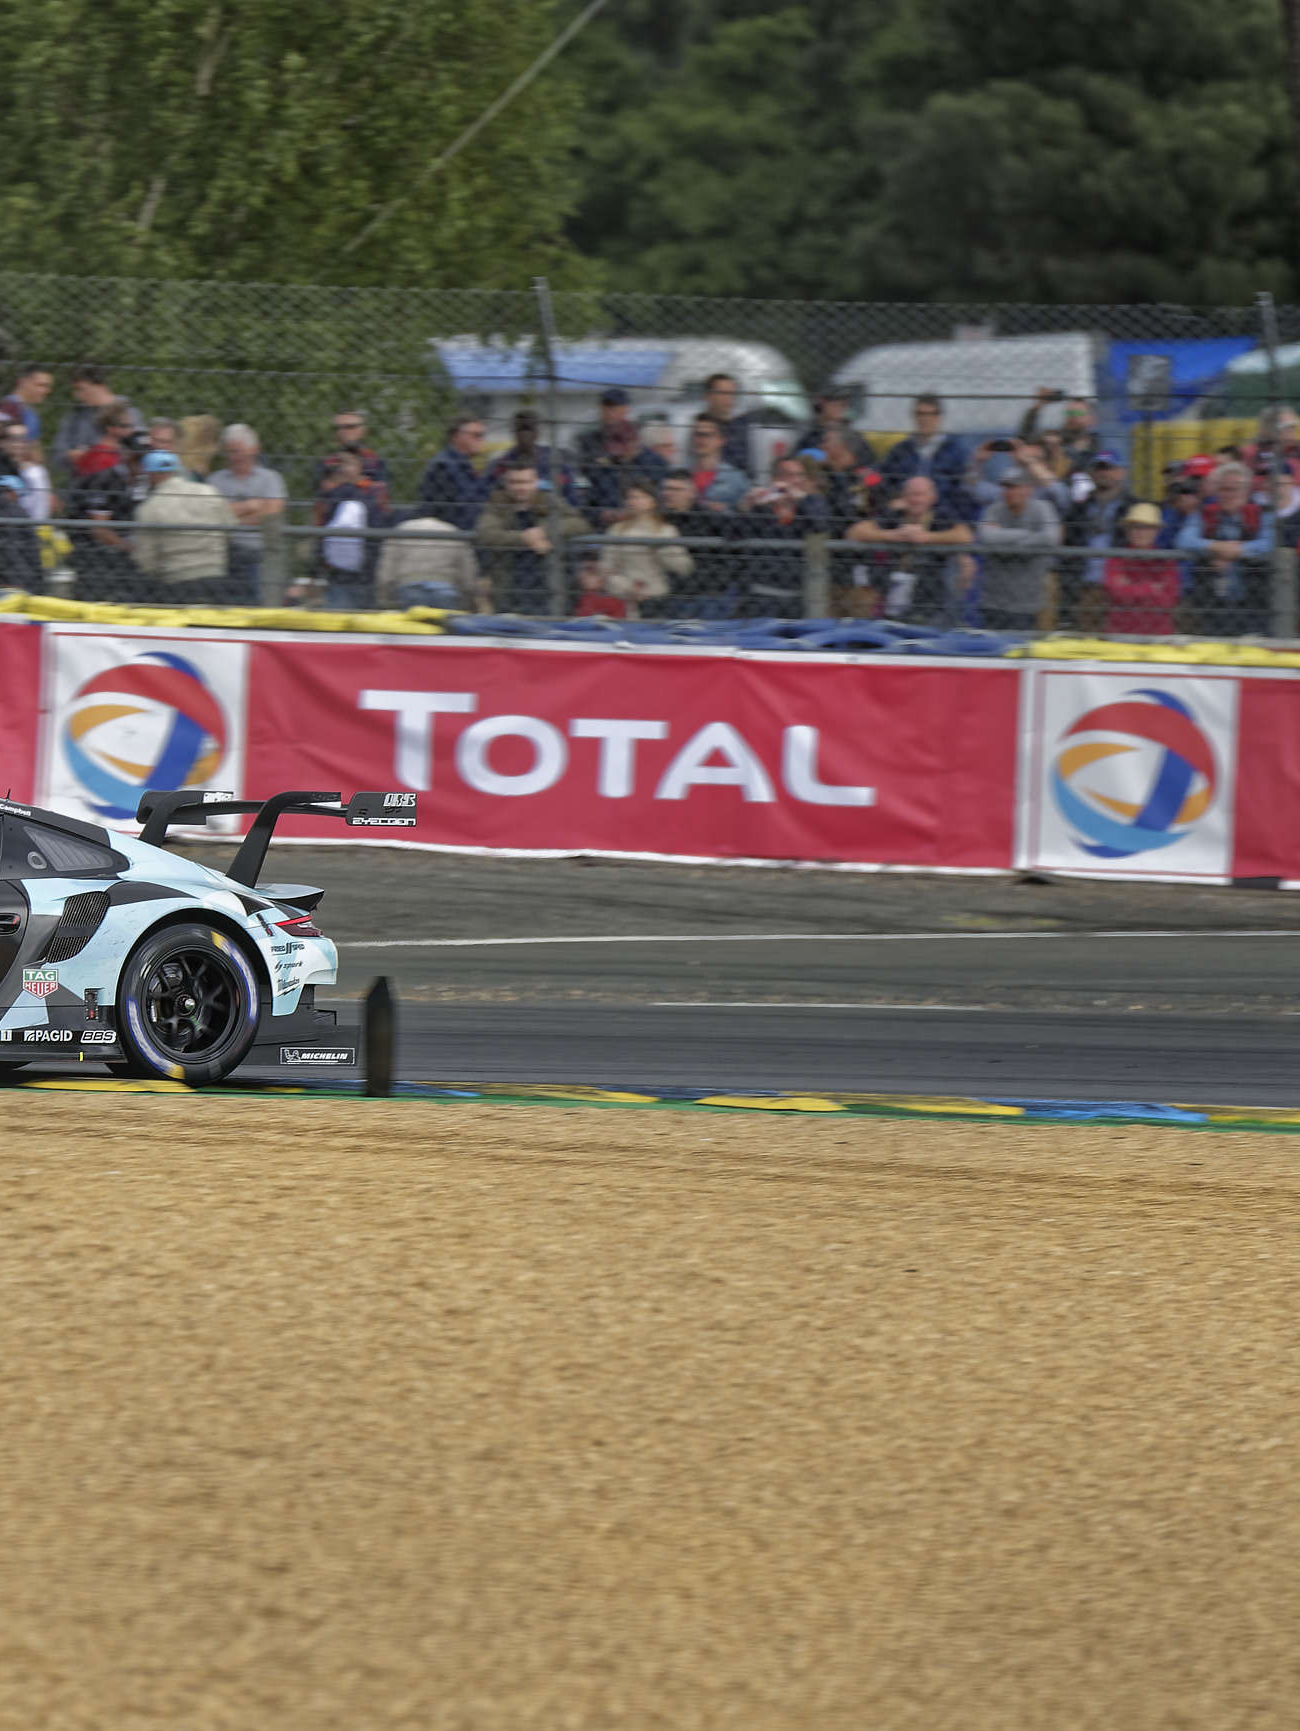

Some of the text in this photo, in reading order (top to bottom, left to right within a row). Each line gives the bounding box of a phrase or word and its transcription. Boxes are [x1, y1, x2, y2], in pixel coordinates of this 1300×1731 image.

[357, 689, 878, 807] TOTAL
[0, 804, 32, 816] Campbell
[25, 971, 55, 981] TAG
[24, 982, 56, 997] HEUER
[37, 1029, 73, 1042] PAGID
[80, 1030, 116, 1044] BBS
[301, 1052, 348, 1060] MICHELIN
